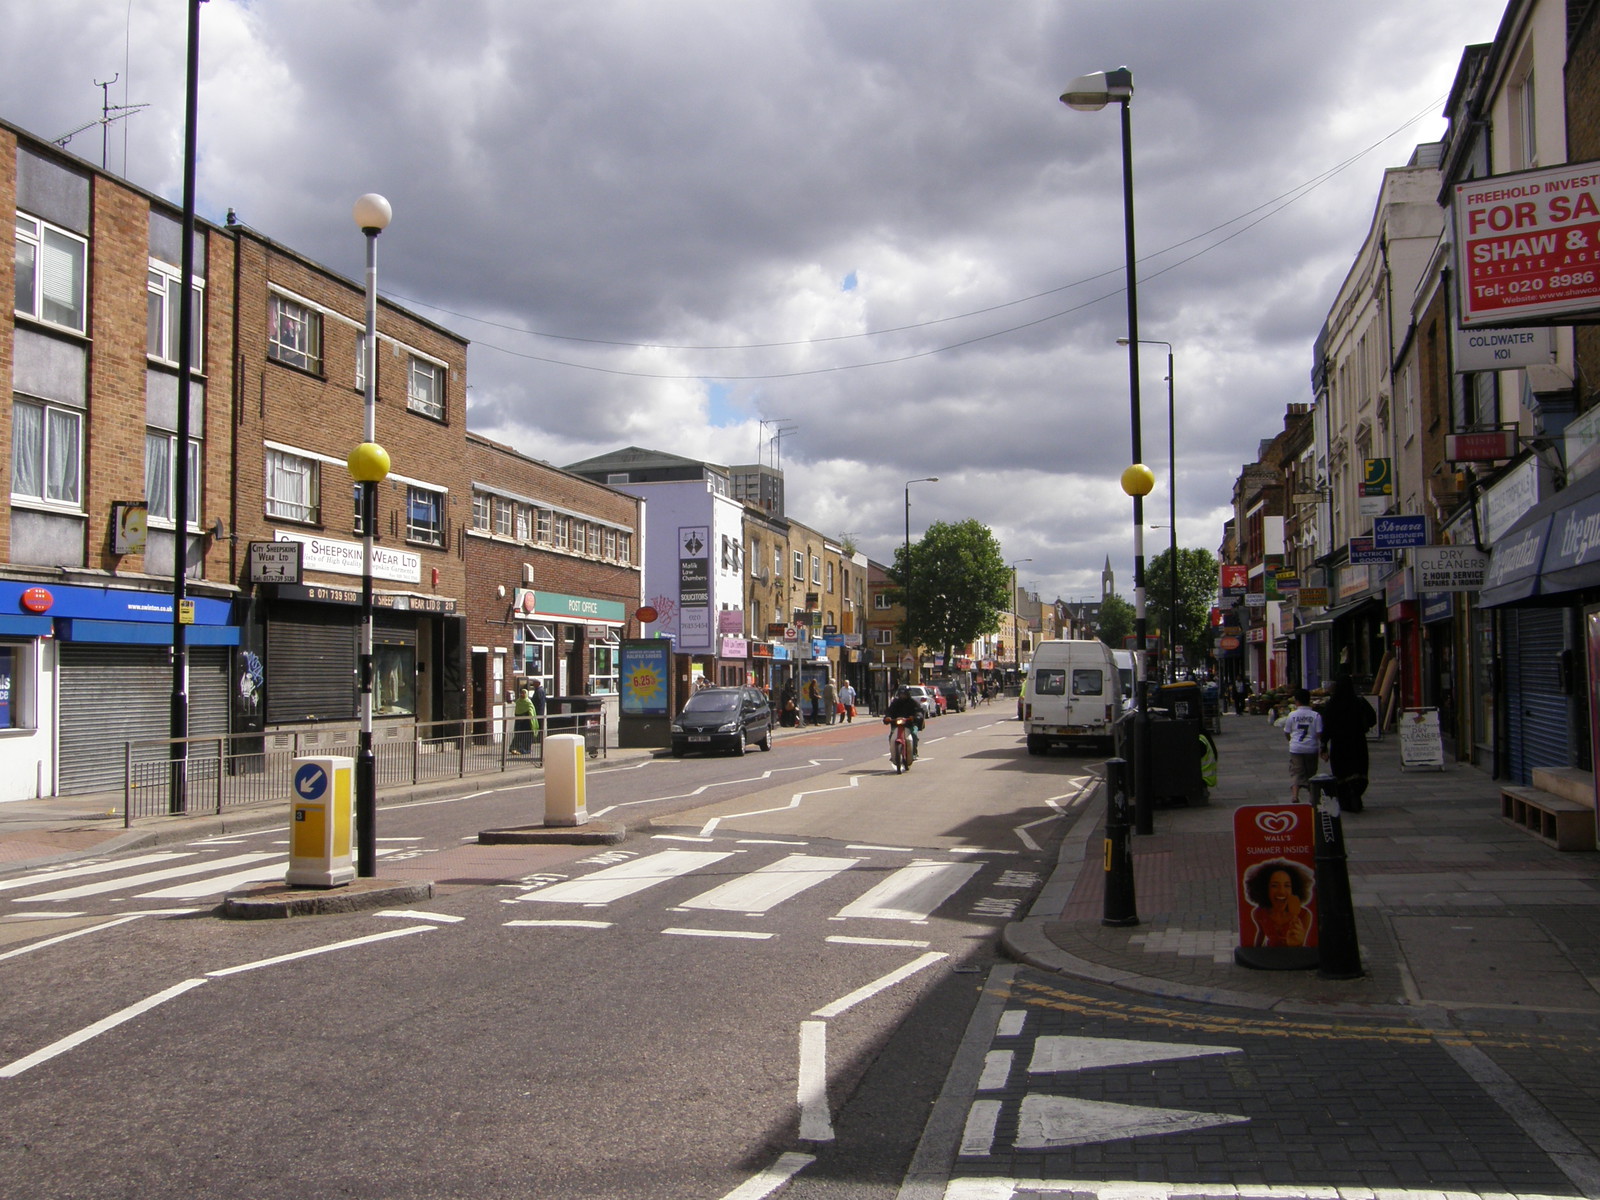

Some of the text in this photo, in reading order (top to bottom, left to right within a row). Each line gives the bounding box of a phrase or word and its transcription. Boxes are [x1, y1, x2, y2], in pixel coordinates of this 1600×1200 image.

[1467, 174, 1600, 205] FREEHOLD INVEST
[1468, 192, 1600, 235] FOR SA
[1473, 229, 1589, 264] SHAW &
[1474, 250, 1600, 276] ESTATE AGE
[1474, 271, 1595, 298] Tel: 020 8986
[1502, 287, 1600, 304] Website: www.shawco.
[1469, 332, 1534, 348] COLDWATER
[1494, 349, 1511, 360] KOI
[1377, 532, 1424, 540] DESIGNER
[258, 552, 289, 562] WEAR LTD
[311, 540, 363, 560] SHEEPSKIN
[371, 551, 399, 565] WEAR
[402, 554, 418, 568] LTD
[1440, 550, 1464, 560] DRY
[326, 556, 341, 566] High
[1420, 559, 1486, 571] CLEANERS
[1430, 572, 1451, 580] HOUR
[1452, 570, 1484, 579] SERVICE
[317, 588, 357, 603] 071 739 5130
[680, 593, 709, 601] SOLICITORS
[127, 603, 174, 613] www.swinton.co.uk
[410, 598, 425, 610] WEAR
[426, 600, 436, 611] LTD
[445, 601, 454, 611] 219
[568, 599, 598, 615] POST OFFICE
[1297, 723, 1310, 743] 7
[296, 811, 303, 820] 3
[1264, 834, 1293, 842] WALL'S
[1246, 845, 1310, 855] SUMMER INSIDE
